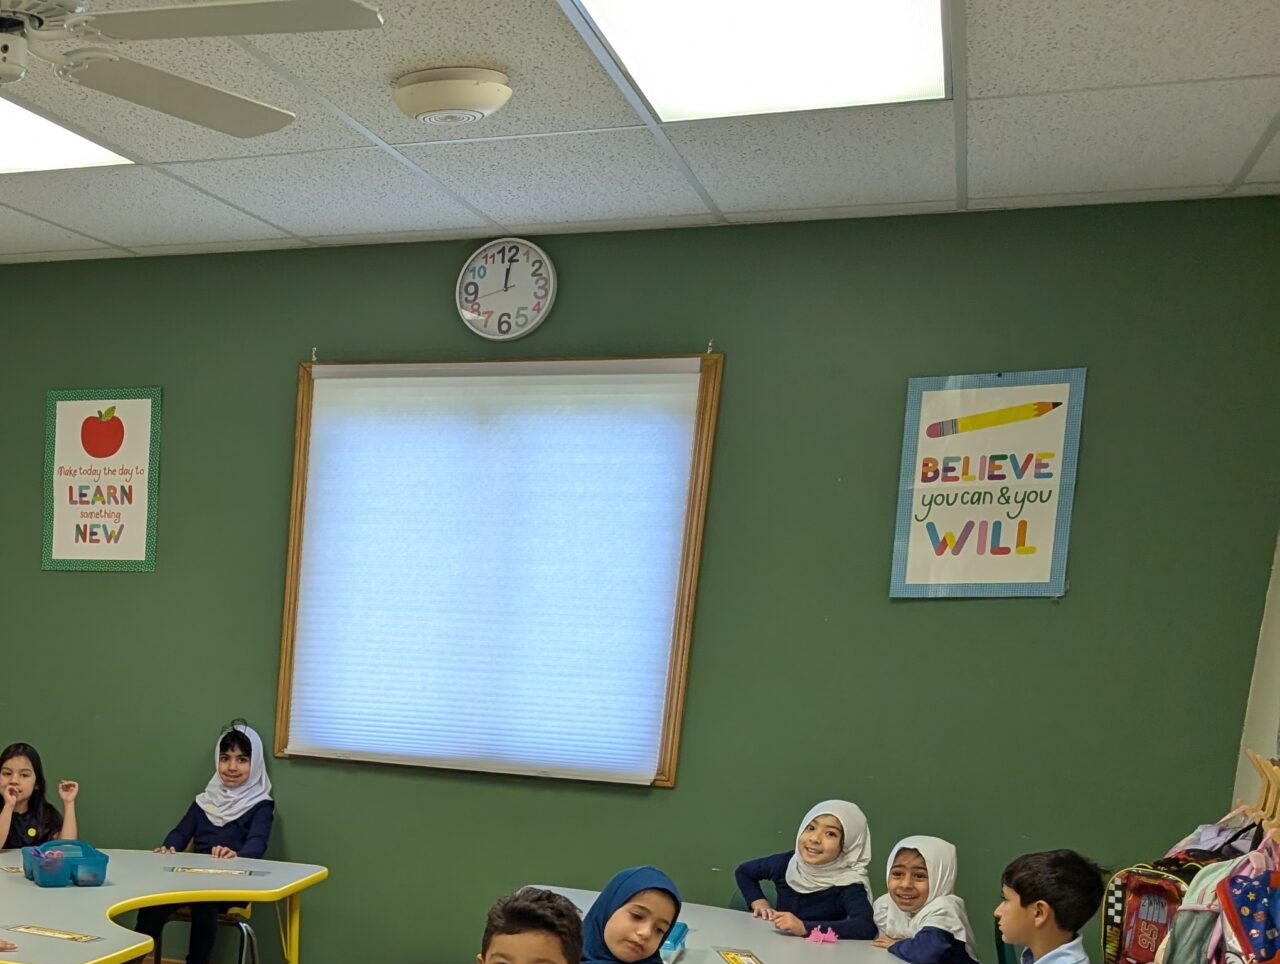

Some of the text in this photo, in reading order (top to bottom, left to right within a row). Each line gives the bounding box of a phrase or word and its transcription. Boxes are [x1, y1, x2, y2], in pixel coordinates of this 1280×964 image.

[482, 252, 496, 265] 11
[496, 245, 520, 264] 12
[522, 249, 530, 263] 1
[469, 264, 487, 279] 10
[531, 259, 544, 277] 2
[464, 281, 479, 304] 9
[533, 277, 549, 300] 3
[515, 306, 528, 328] 5
[531, 301, 543, 314] 4
[482, 310, 494, 328] 7
[497, 312, 512, 335] 6
[57, 464, 145, 483] Make today the day to
[920, 452, 1056, 484] BELIEVE
[68, 484, 133, 506] LEARN
[914, 486, 1053, 523] you can & you
[79, 508, 122, 524] something
[74, 523, 125, 544] NEW
[925, 519, 1038, 557] WILL
[1138, 920, 1159, 953] 95
